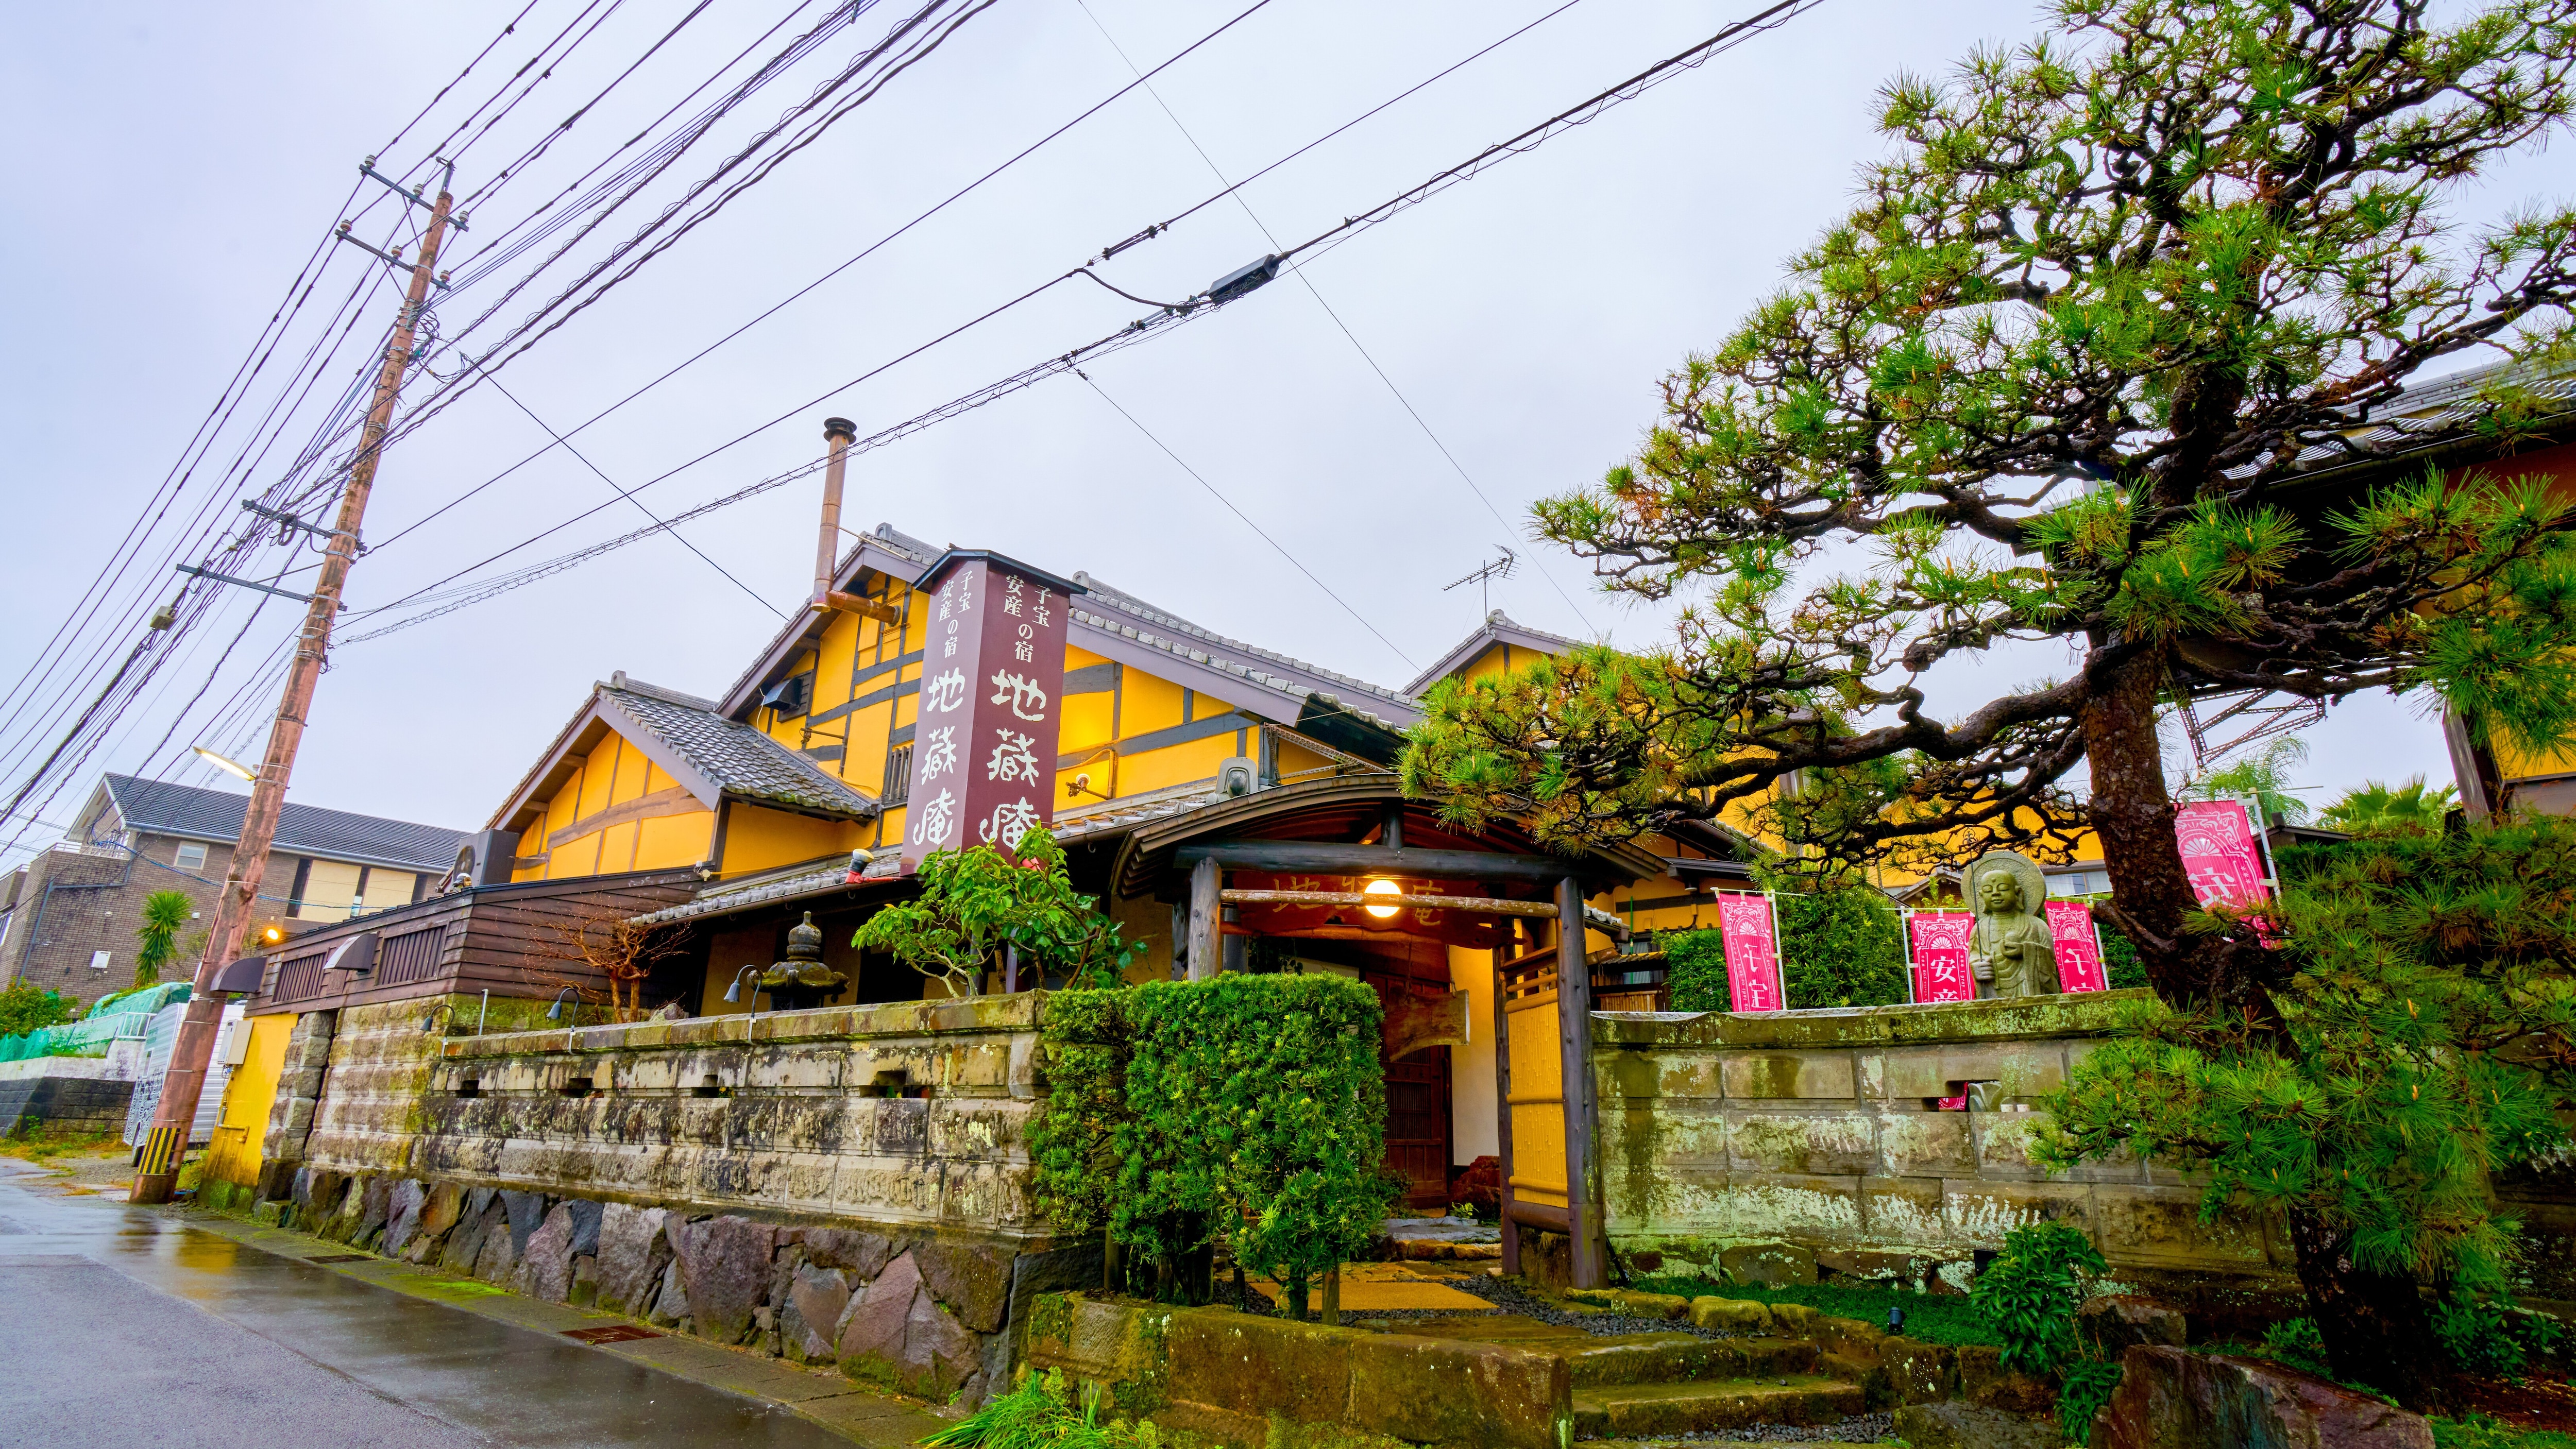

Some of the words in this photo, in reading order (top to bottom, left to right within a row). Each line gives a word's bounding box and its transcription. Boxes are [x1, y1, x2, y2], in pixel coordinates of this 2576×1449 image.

[939, 579, 954, 622] 安産
[958, 570, 973, 613] 子宝
[1004, 574, 1025, 618] 安産
[1032, 584, 1052, 627] 子宝
[944, 619, 958, 658] の宿
[1015, 624, 1034, 663] の宿
